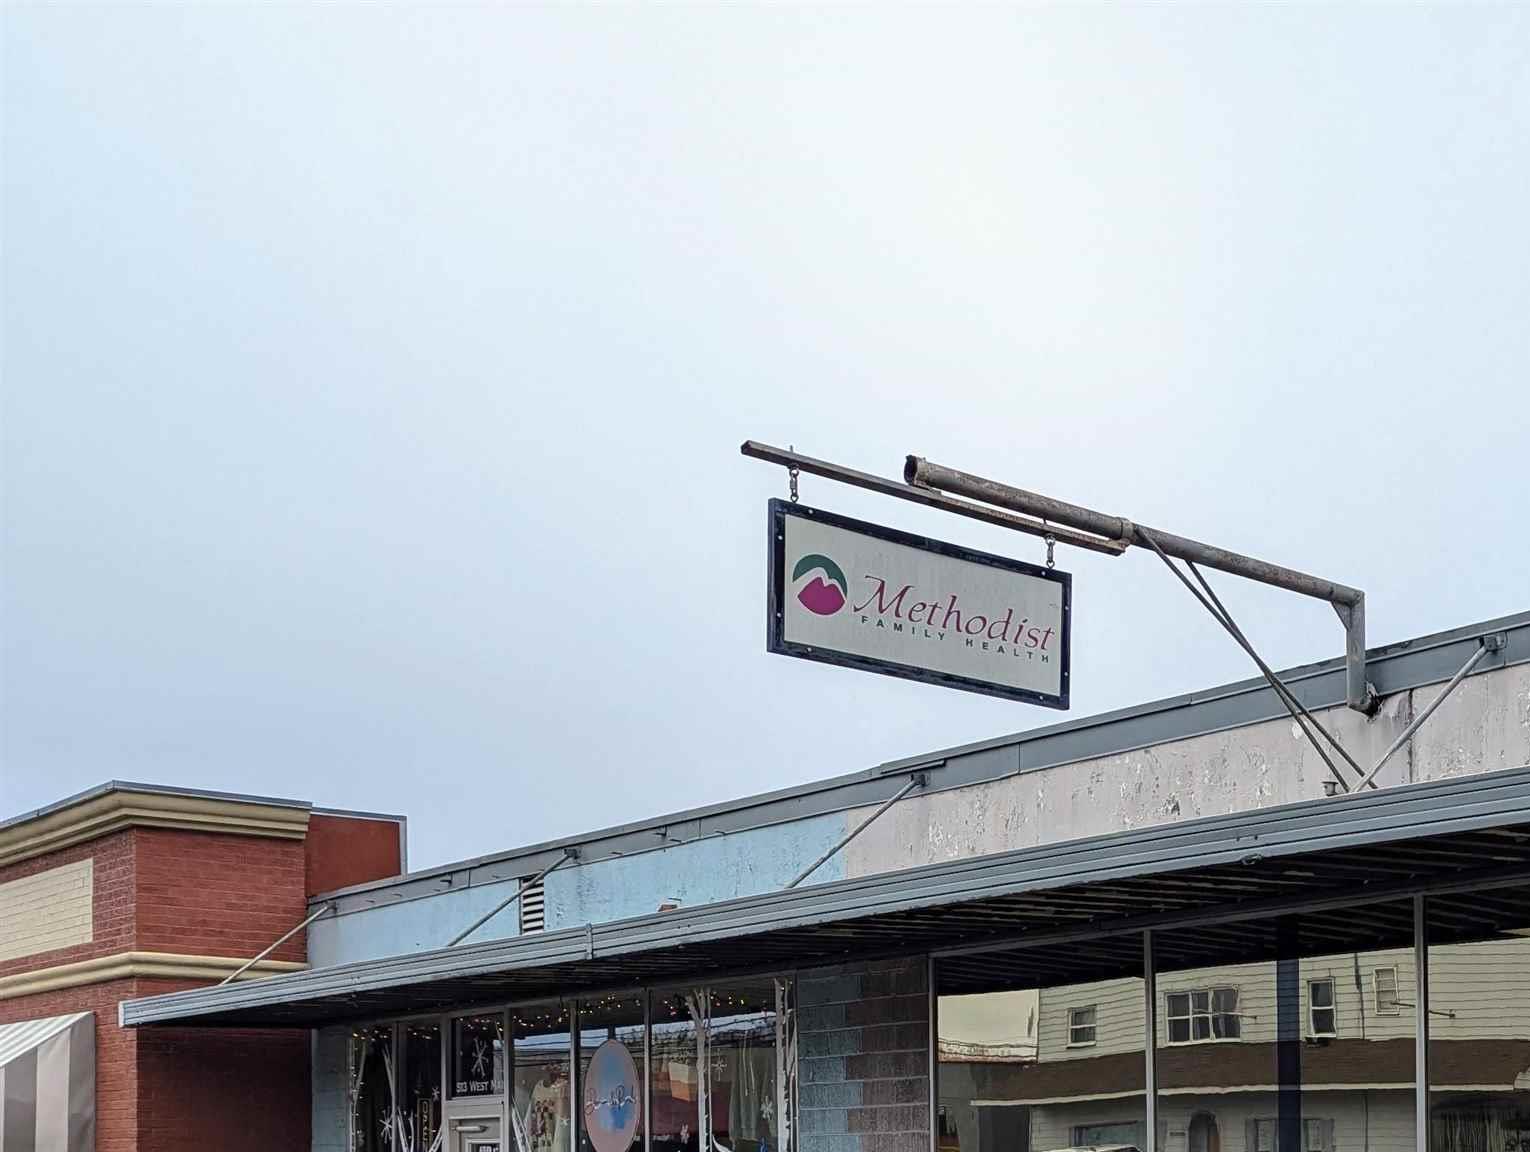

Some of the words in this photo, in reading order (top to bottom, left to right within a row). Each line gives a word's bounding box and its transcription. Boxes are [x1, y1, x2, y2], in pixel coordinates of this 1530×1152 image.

[853, 575, 1055, 650] Methodist
[861, 616, 946, 641] FAMILY
[966, 638, 1049, 663] HEALTH
[469, 1080, 489, 1092] WEST
